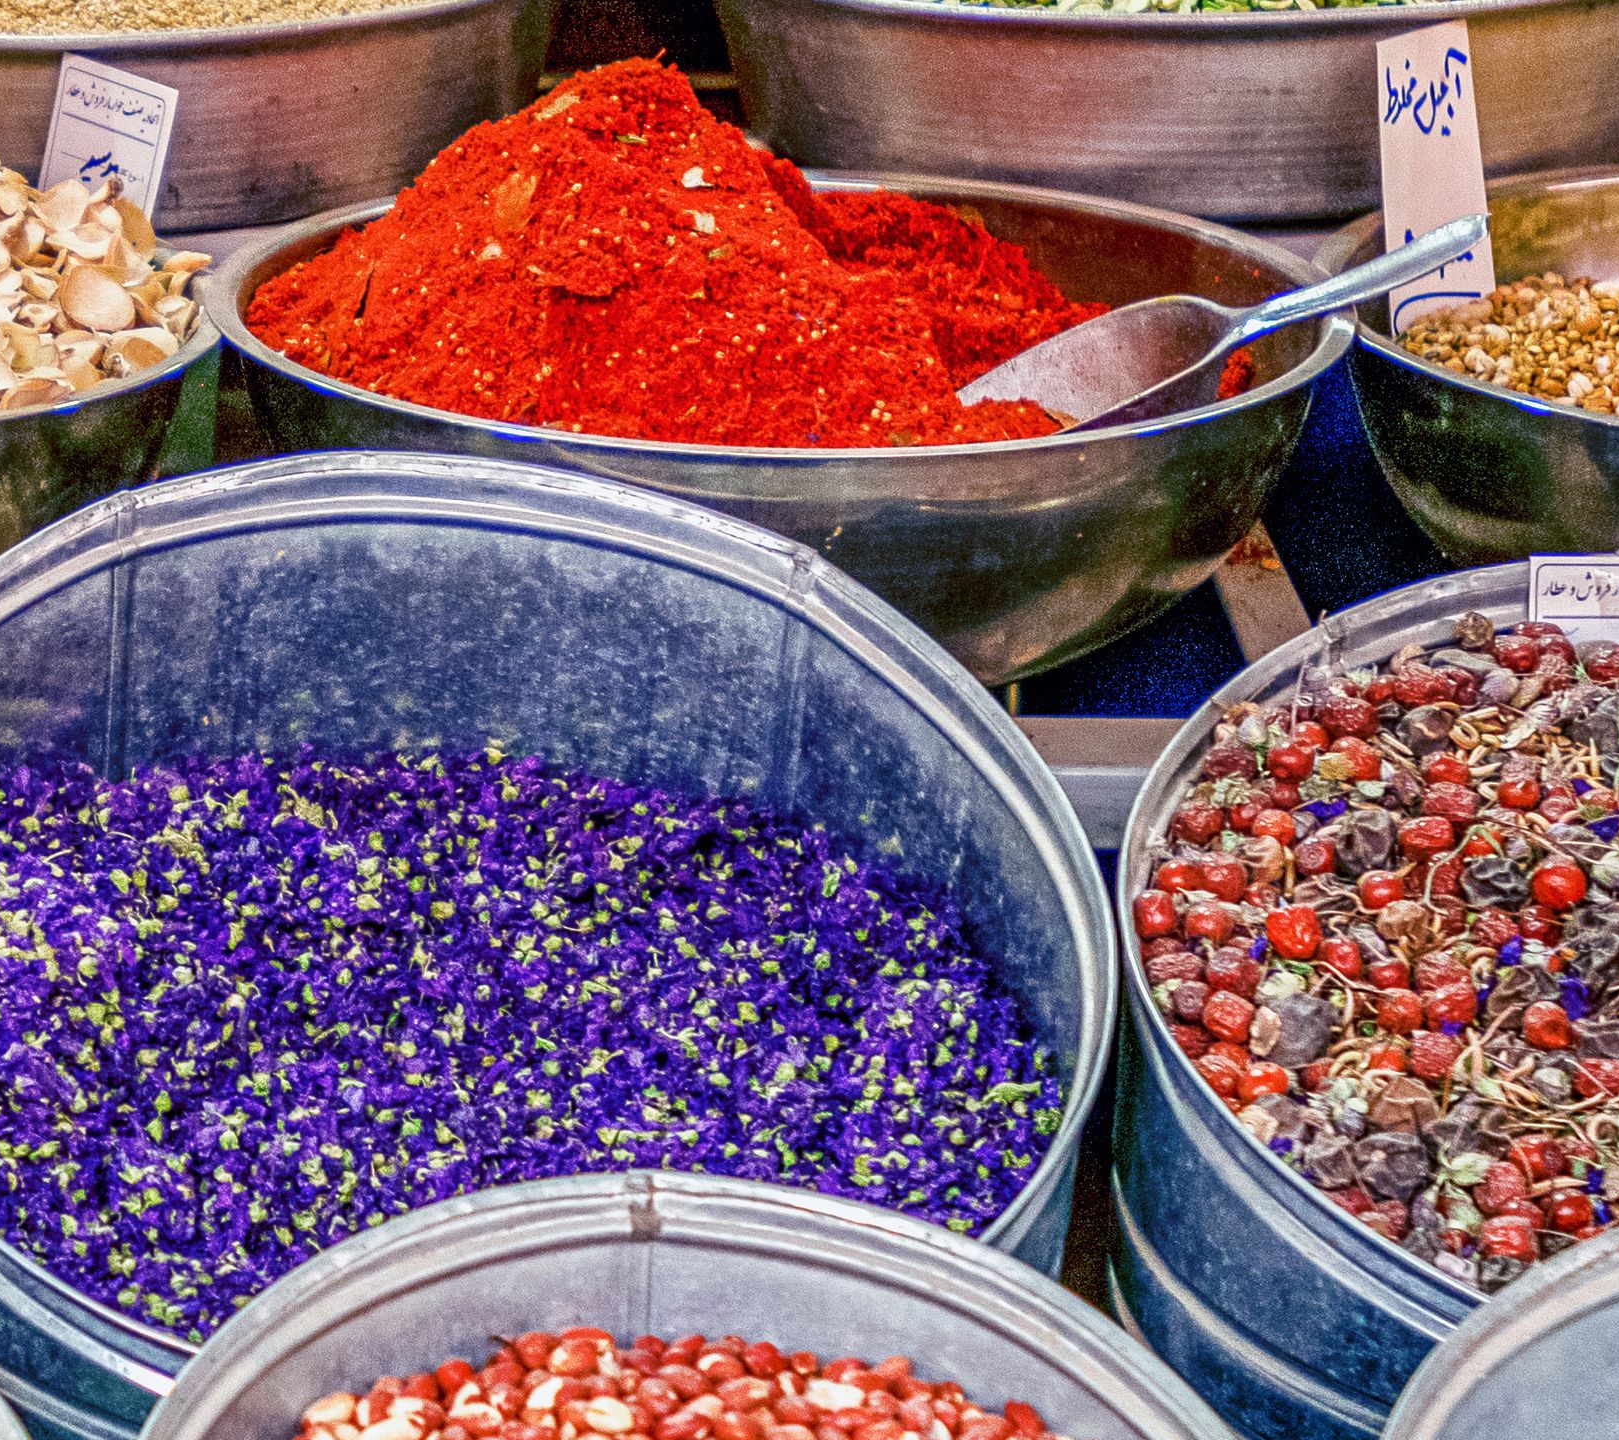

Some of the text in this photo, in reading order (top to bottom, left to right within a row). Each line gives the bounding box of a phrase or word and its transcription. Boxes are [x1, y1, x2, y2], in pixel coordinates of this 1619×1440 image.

[1383, 47, 1468, 138] آجیل مخلوط
[1542, 580, 1568, 597] عطار
[1575, 571, 1611, 602] فروش
